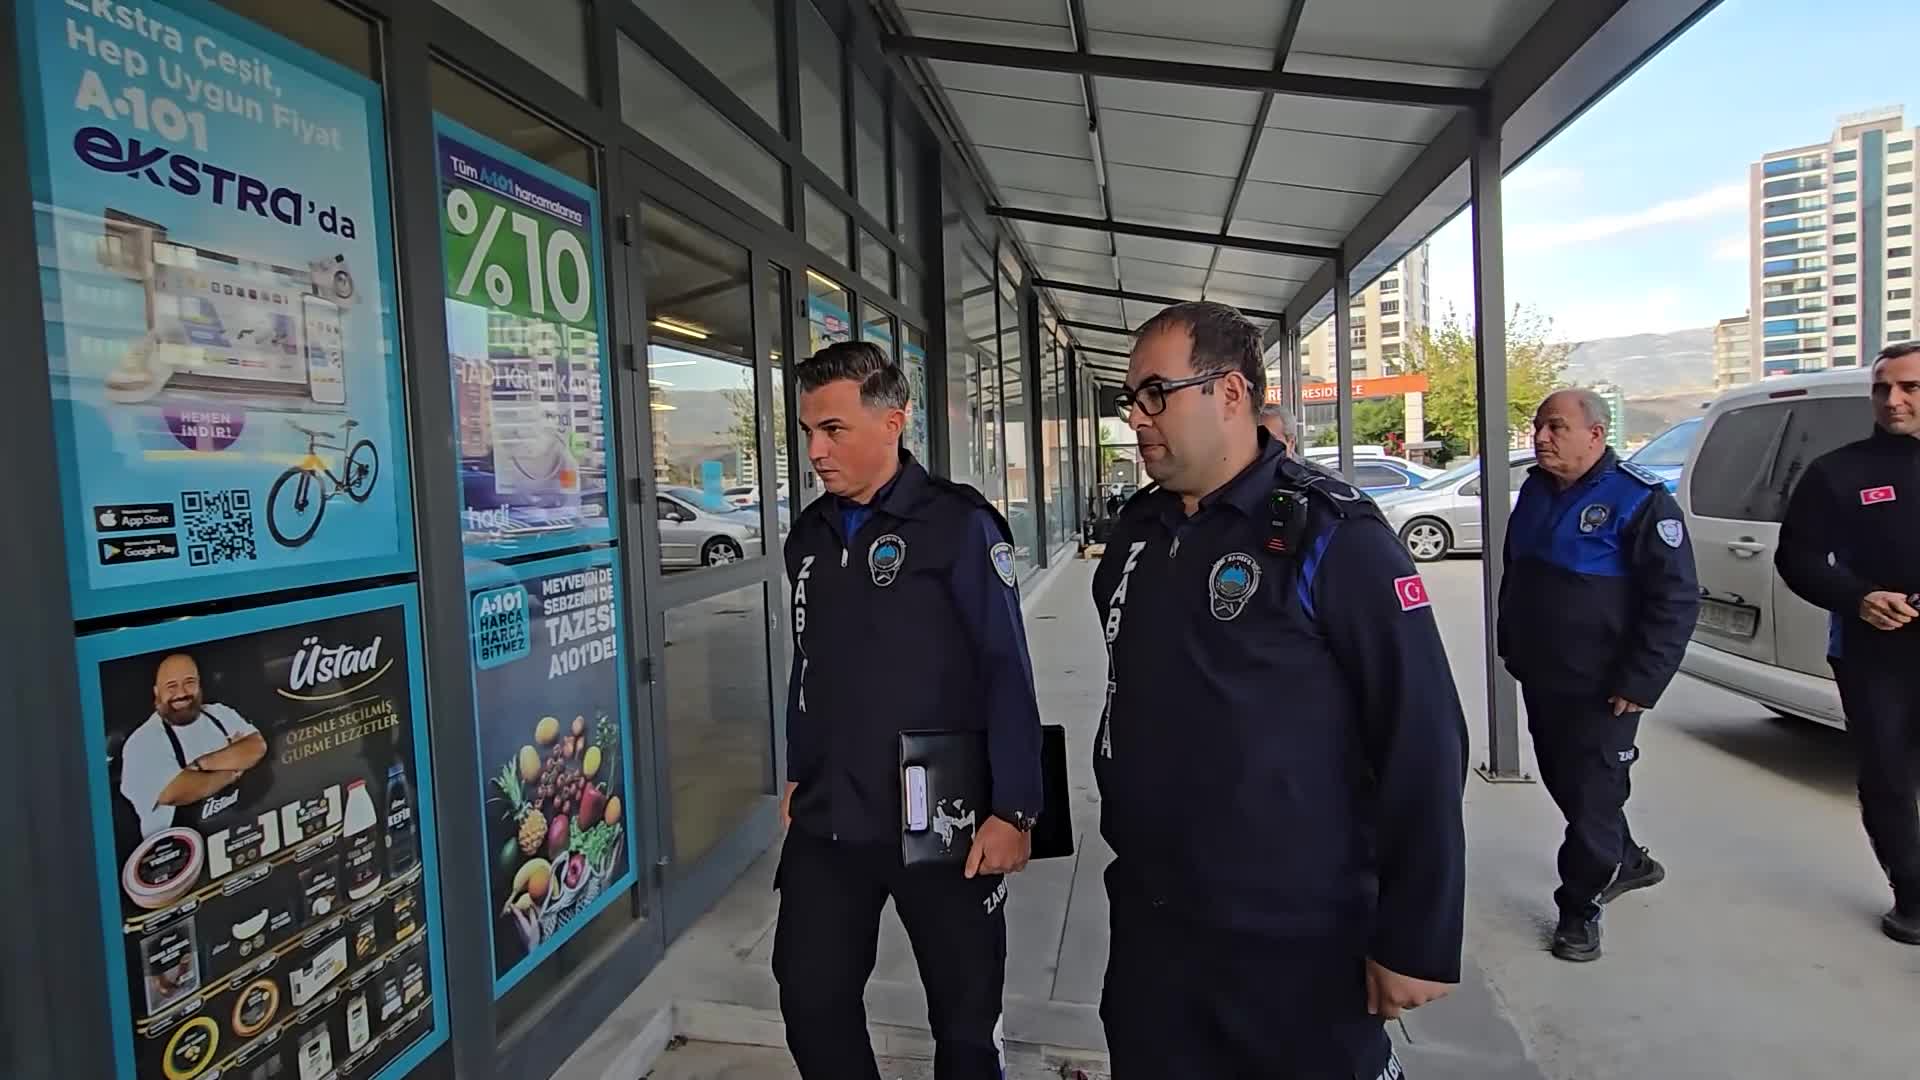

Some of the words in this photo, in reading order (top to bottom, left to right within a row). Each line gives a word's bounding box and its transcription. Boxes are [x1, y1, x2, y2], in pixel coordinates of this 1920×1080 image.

[66, 17, 147, 77] Hep
[158, 55, 263, 123] Uygun
[272, 103, 343, 152] Fiyat
[449, 155, 478, 180] Tüm
[447, 188, 591, 322] %10
[181, 411, 231, 424] HEMEN
[121, 515, 144, 528] App
[143, 514, 169, 524] Store
[467, 503, 509, 529] hadi
[123, 545, 157, 558] Google
[156, 544, 176, 555] Play
[599, 567, 613, 583] DE
[600, 584, 614, 600] DE
[480, 610, 524, 631] HARCA
[481, 626, 524, 648] HARCA
[289, 636, 382, 690] Üstad
[334, 713, 399, 746] LEZZETLER
[983, 880, 1006, 915] ZABI
